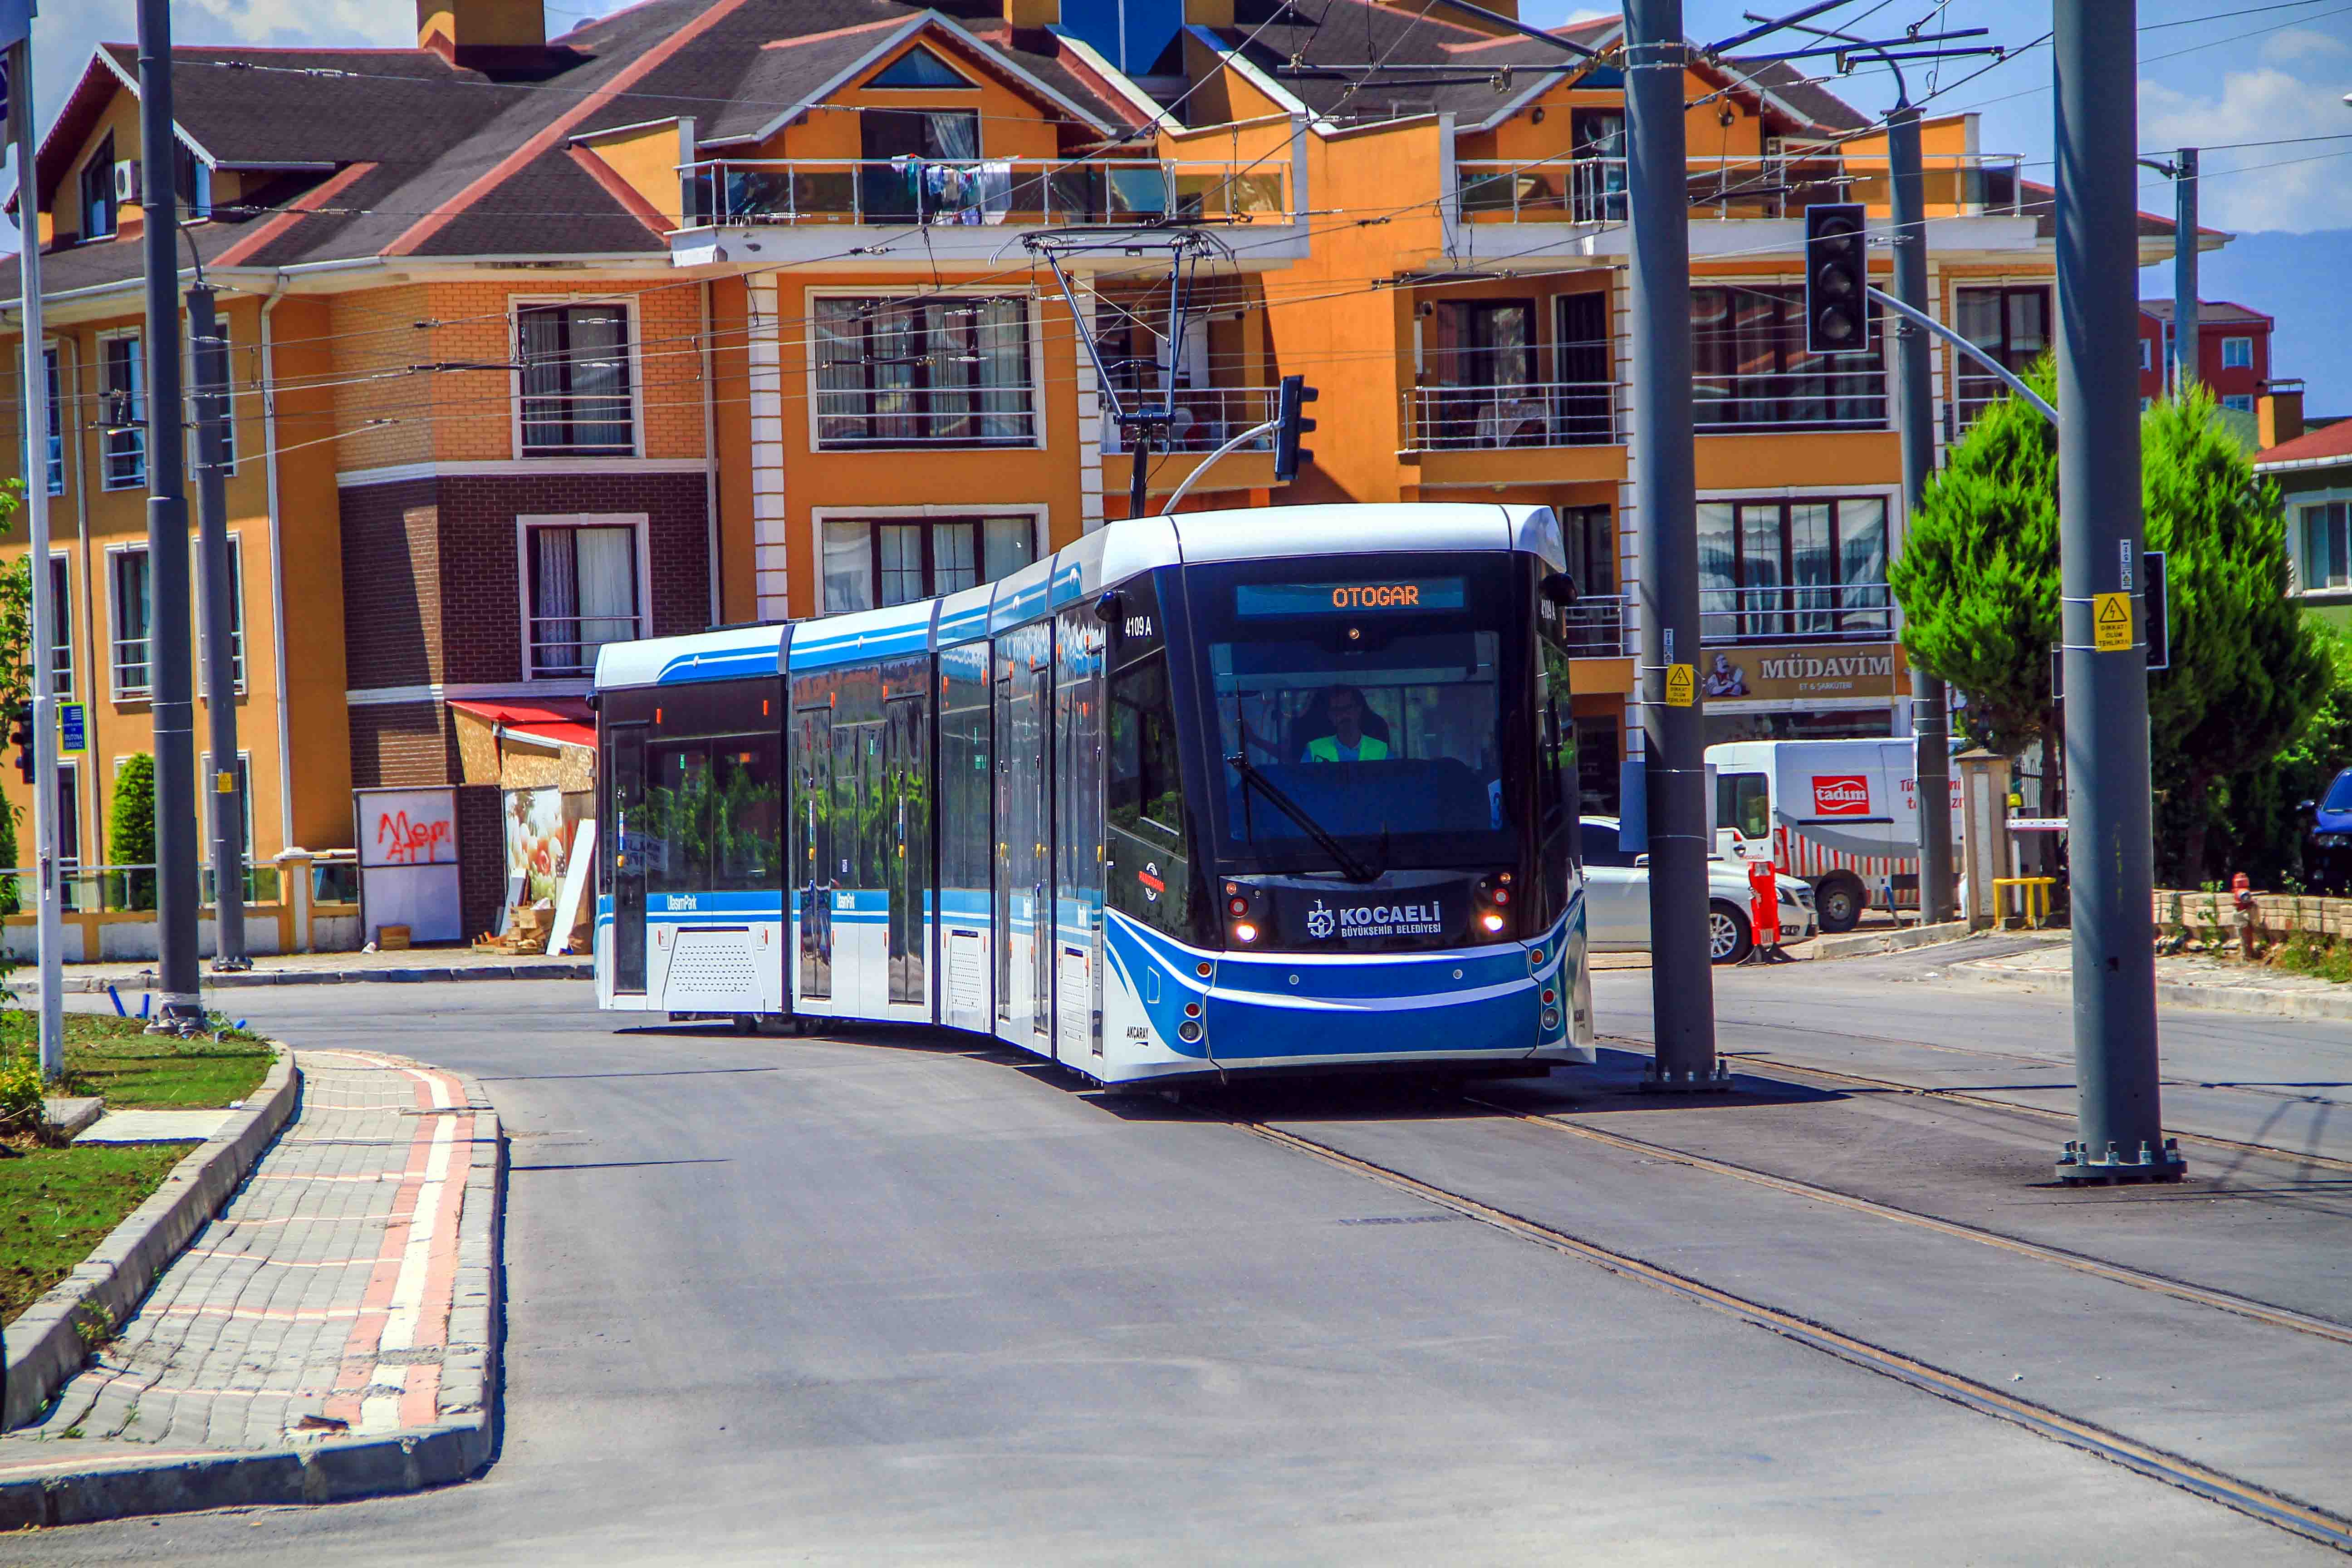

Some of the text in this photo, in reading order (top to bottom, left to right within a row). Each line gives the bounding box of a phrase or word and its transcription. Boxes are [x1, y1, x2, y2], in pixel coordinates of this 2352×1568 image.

[1333, 586, 1419, 608] OTOGAR
[1125, 616, 1152, 637] 4109 A
[1761, 652, 1892, 679] MÜDAVİM
[1816, 787, 1867, 801] tadım
[1340, 901, 1441, 926] KOCAELİ
[1342, 922, 1441, 937] BÜYÜKŞEHİR BELEDİYESİ
[1127, 1026, 1149, 1040] AKÇARAY
